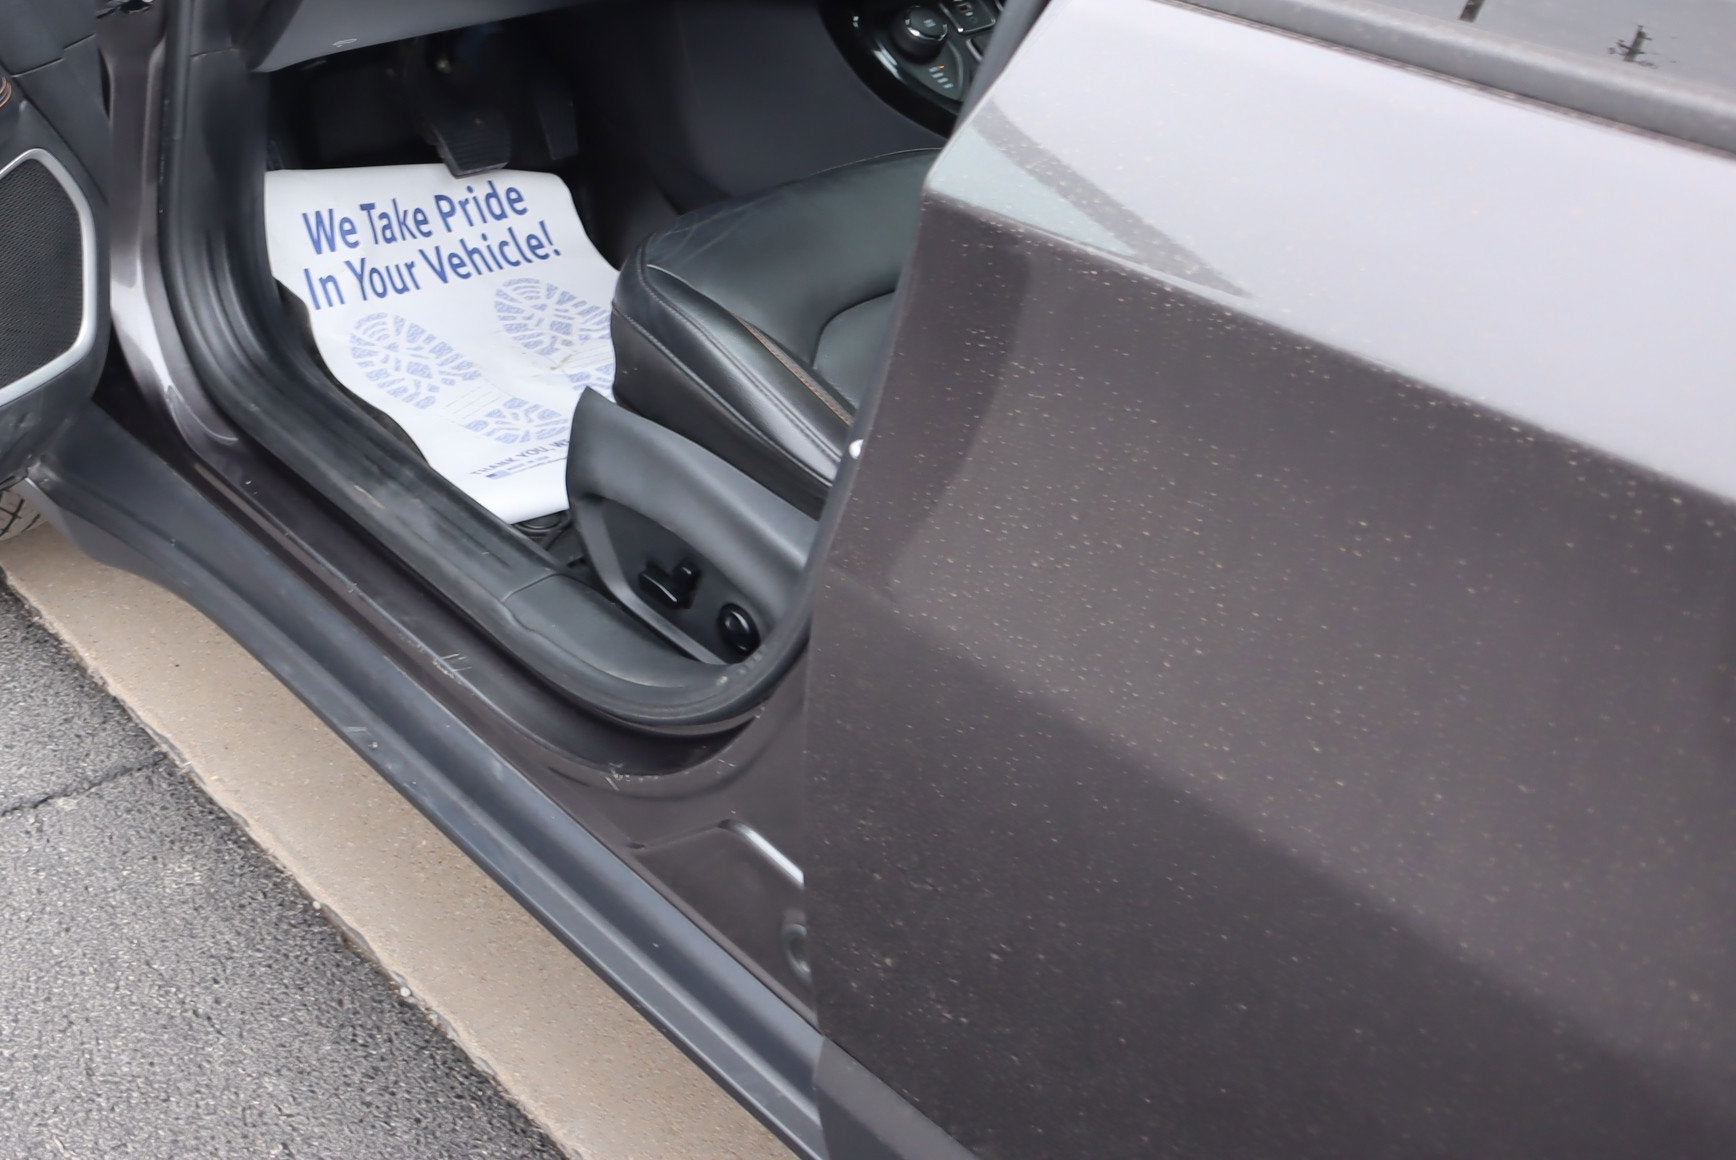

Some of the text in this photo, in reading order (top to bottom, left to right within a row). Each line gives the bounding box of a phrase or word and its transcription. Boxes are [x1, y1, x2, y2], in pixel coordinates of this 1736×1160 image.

[302, 180, 530, 254] We Take Pride
[303, 219, 562, 310] In Your Vehicle!
